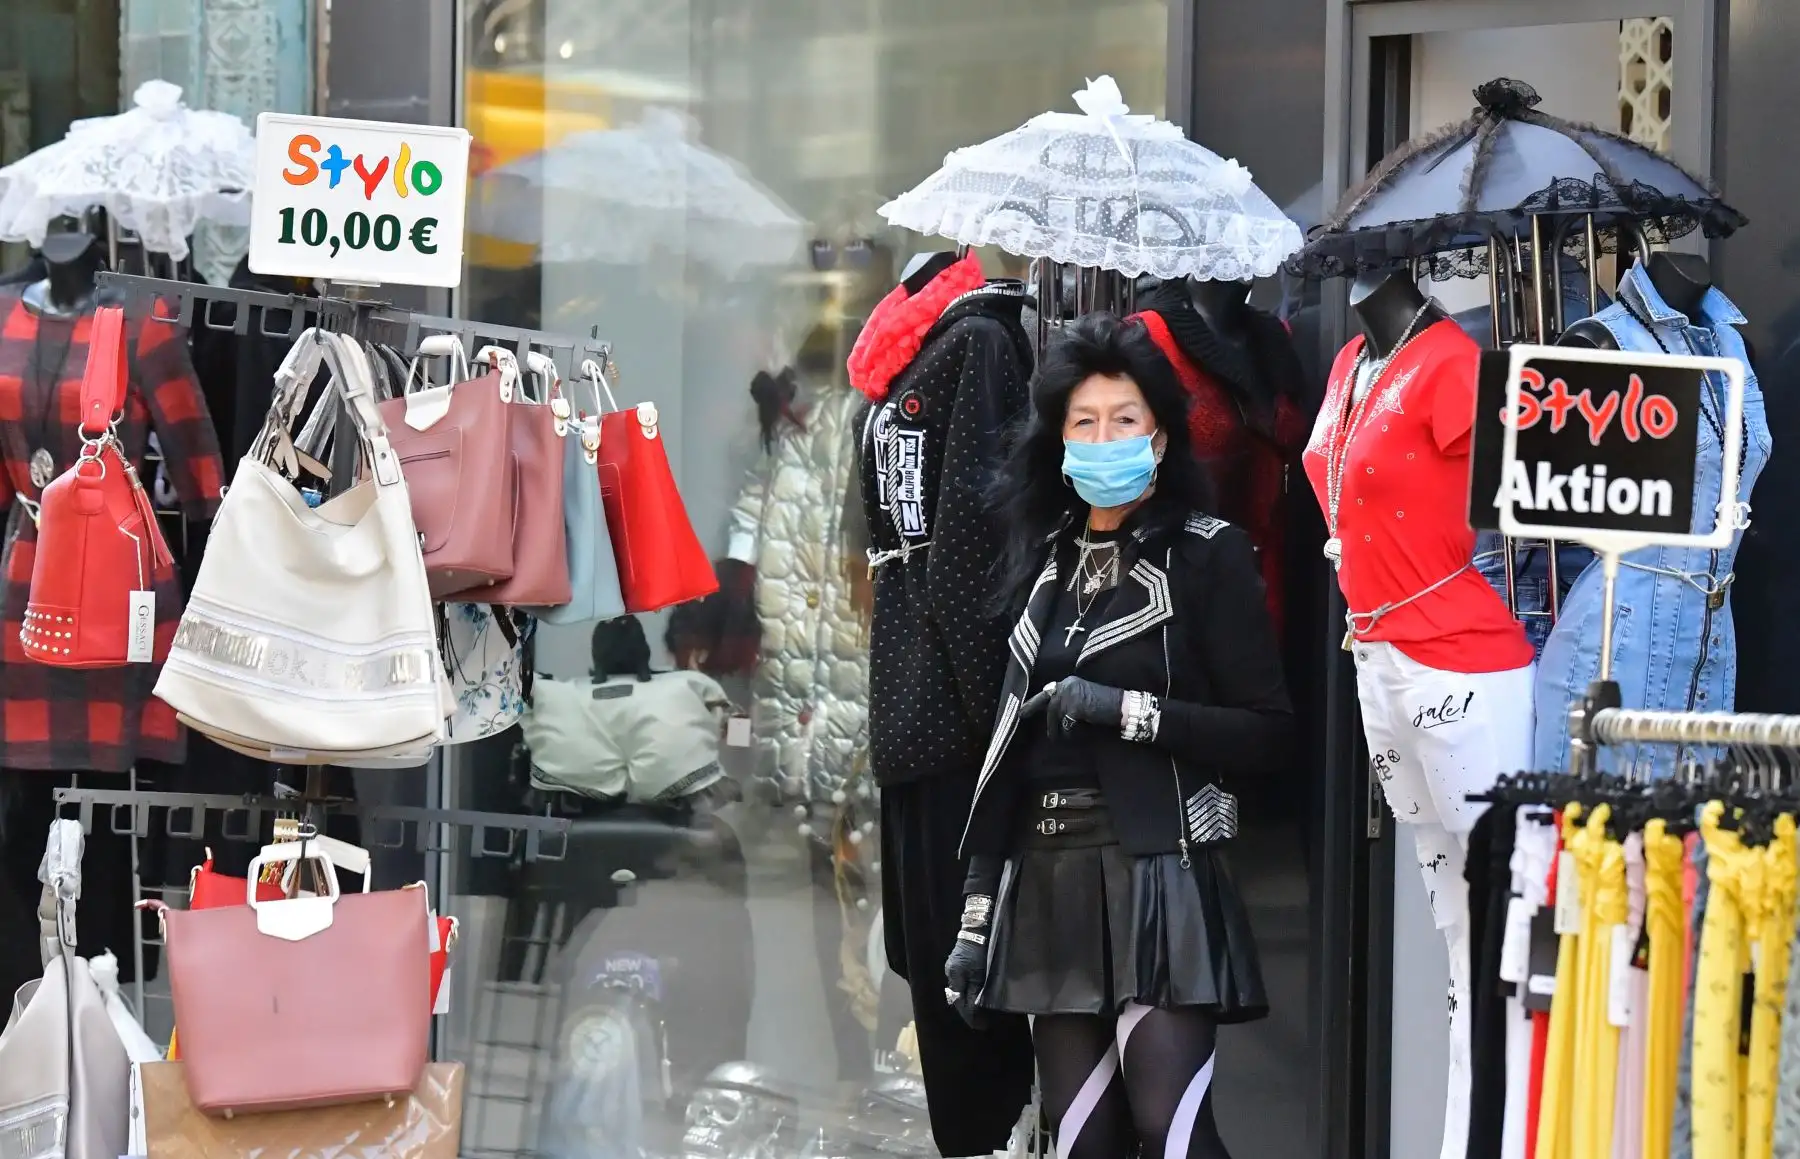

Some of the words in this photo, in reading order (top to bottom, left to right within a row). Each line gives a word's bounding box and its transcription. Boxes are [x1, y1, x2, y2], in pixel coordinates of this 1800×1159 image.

[282, 134, 442, 200] Stylo
[1499, 366, 1678, 447] Stylo
[905, 438, 916, 454] USA
[905, 454, 916, 499] CALIFORNIA
[1493, 459, 1673, 517] Aktion
[1413, 691, 1475, 728] sale!
[605, 958, 641, 972] NEW
